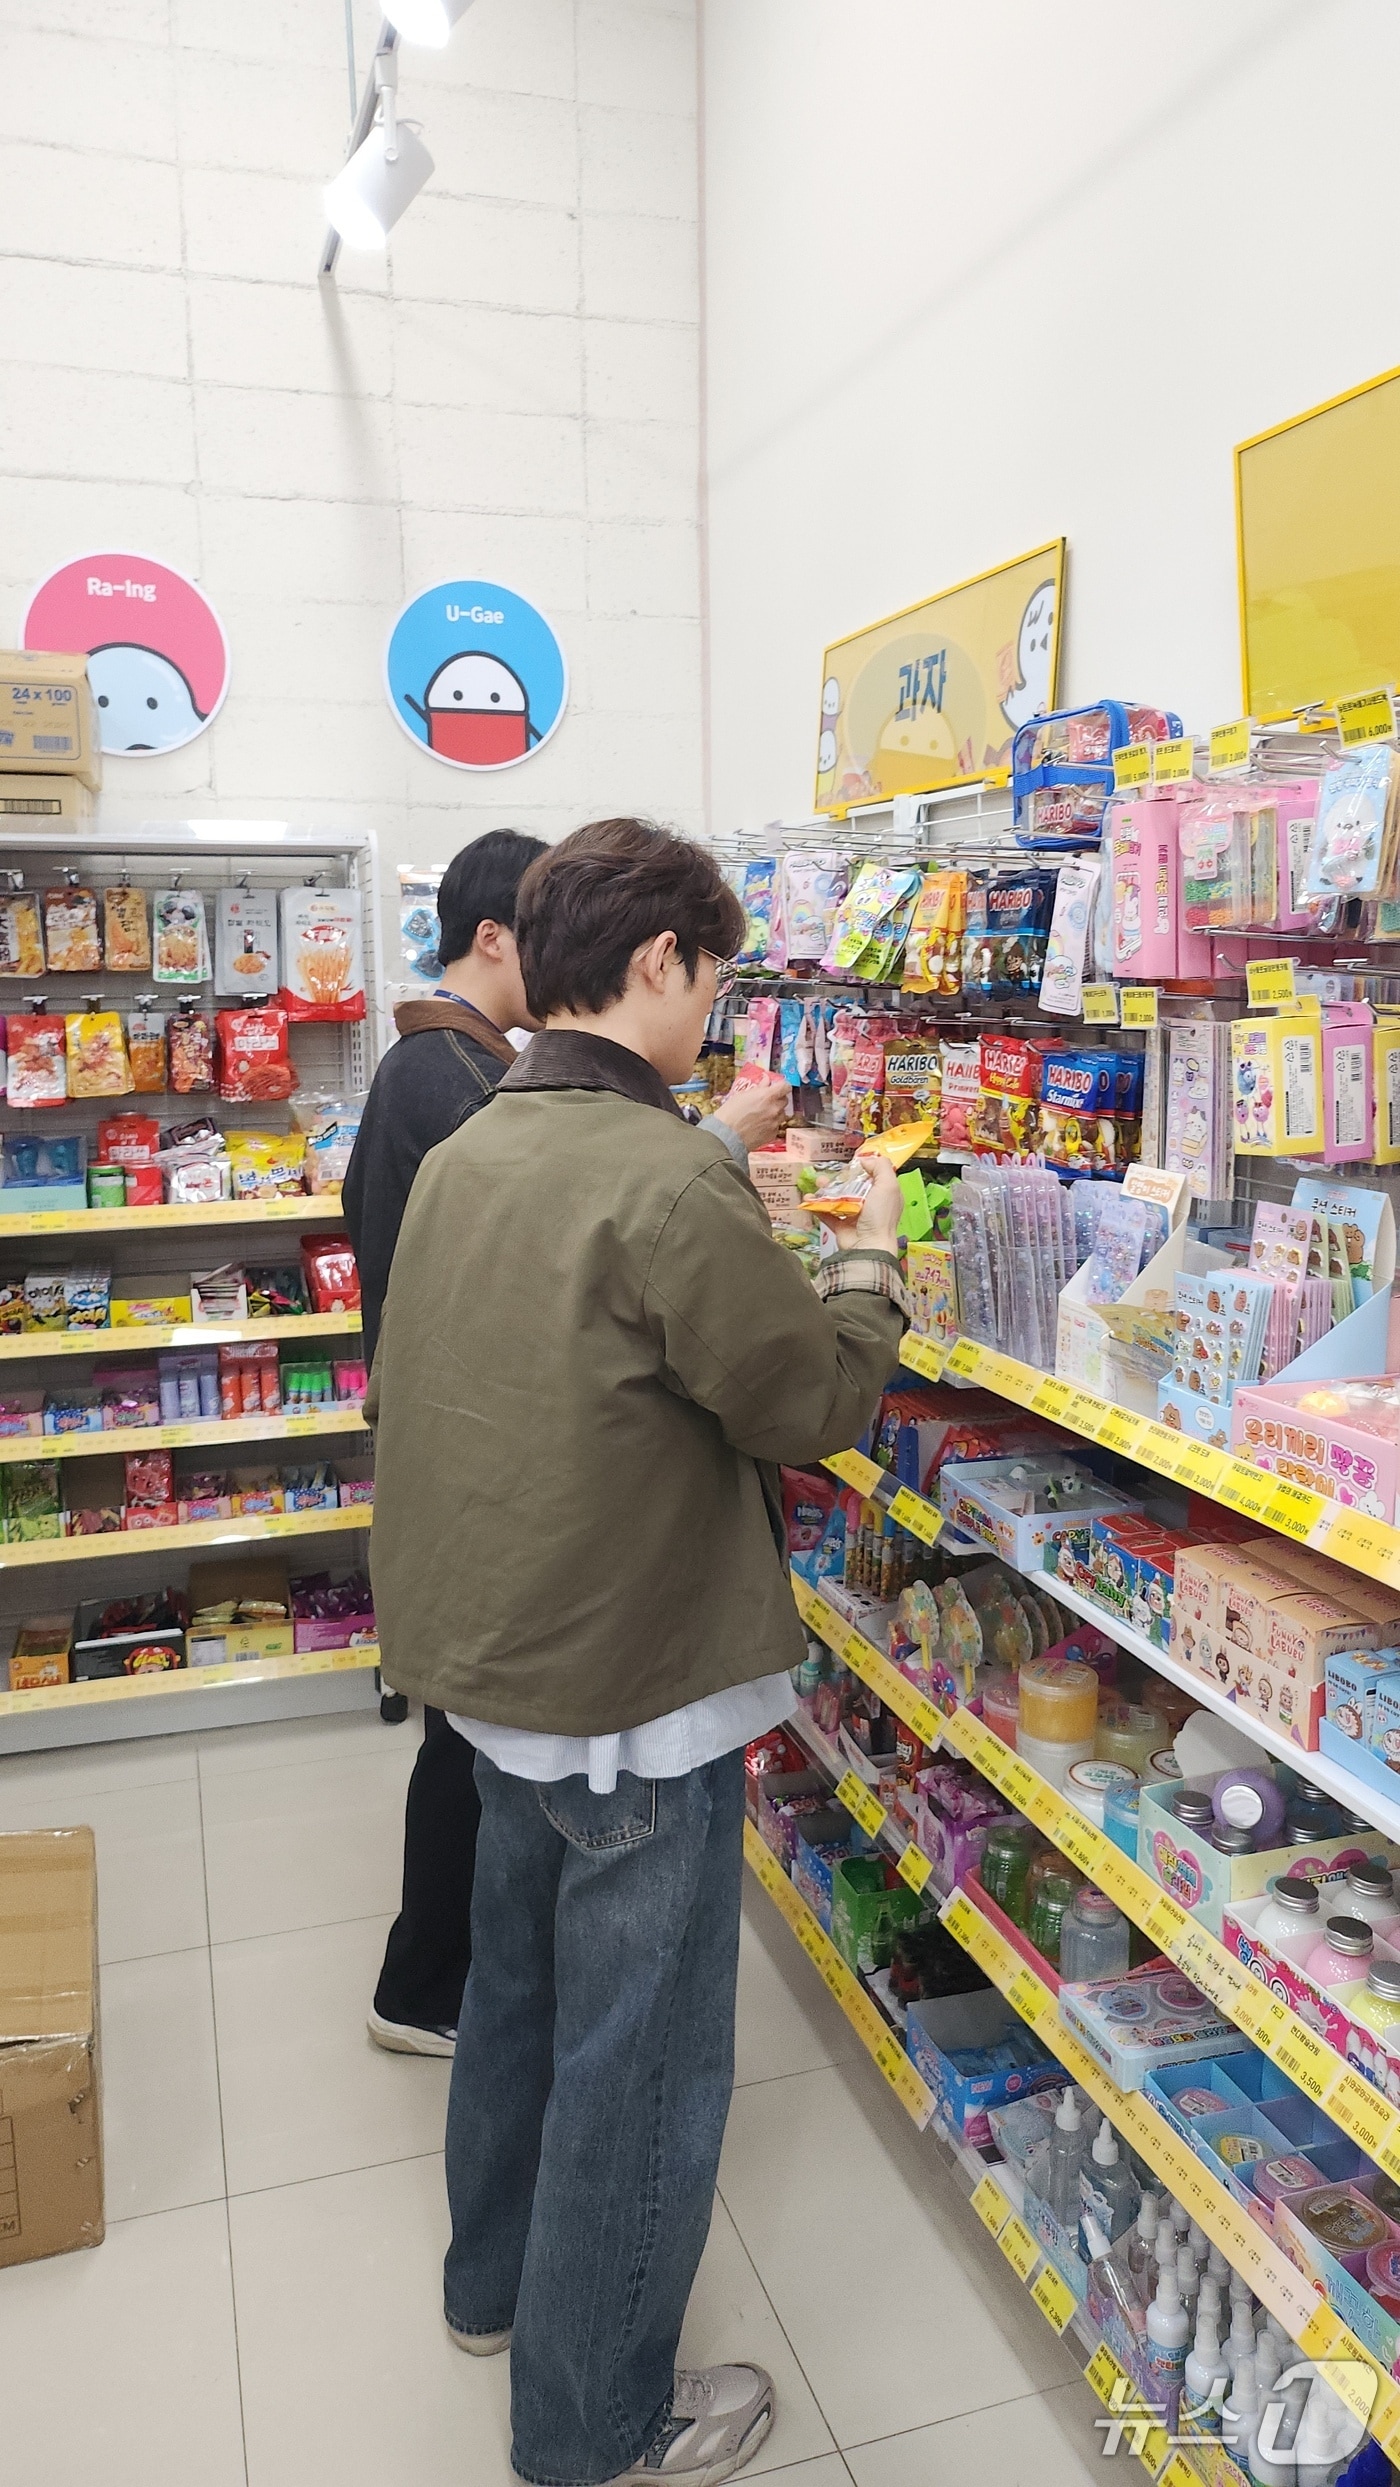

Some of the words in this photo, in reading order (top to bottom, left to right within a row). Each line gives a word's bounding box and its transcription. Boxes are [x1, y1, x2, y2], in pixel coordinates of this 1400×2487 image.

[86, 577, 157, 602] Ra-Ing
[445, 604, 505, 624] U-Gae
[12, 687, 31, 699] 24
[46, 689, 72, 701] 100
[894, 648, 947, 722] 과자
[1368, 723, 1393, 737] 6,000원
[1036, 803, 1073, 824] HARIBO
[988, 887, 1033, 912] HARIBO
[887, 1055, 938, 1073] HARIBO
[1047, 1064, 1093, 1093] HARIBO
[1047, 1090, 1085, 1109] Starmix
[1311, 1197, 1328, 1214] 쿠션
[1329, 1203, 1357, 1217] 스티커
[1244, 1418, 1325, 1466] 우리끼리
[1193, 1474, 1215, 1489] 3,000원
[1239, 1496, 1262, 1512] 4,000원
[1285, 1517, 1309, 1537] 3,000원
[1180, 1567, 1203, 1588] FUNNY
[1180, 1580, 1209, 1606] LABUBU
[1271, 1621, 1298, 1646] FUNNY
[1270, 1634, 1304, 1663] LABUBU
[1327, 1669, 1358, 1693] LIBOBO
[1233, 2006, 1256, 2030] 3,000원
[971, 2079, 994, 2094] NEW
[1300, 2064, 1324, 2097] 3,500원
[1352, 2121, 1378, 2149] 3,000원
